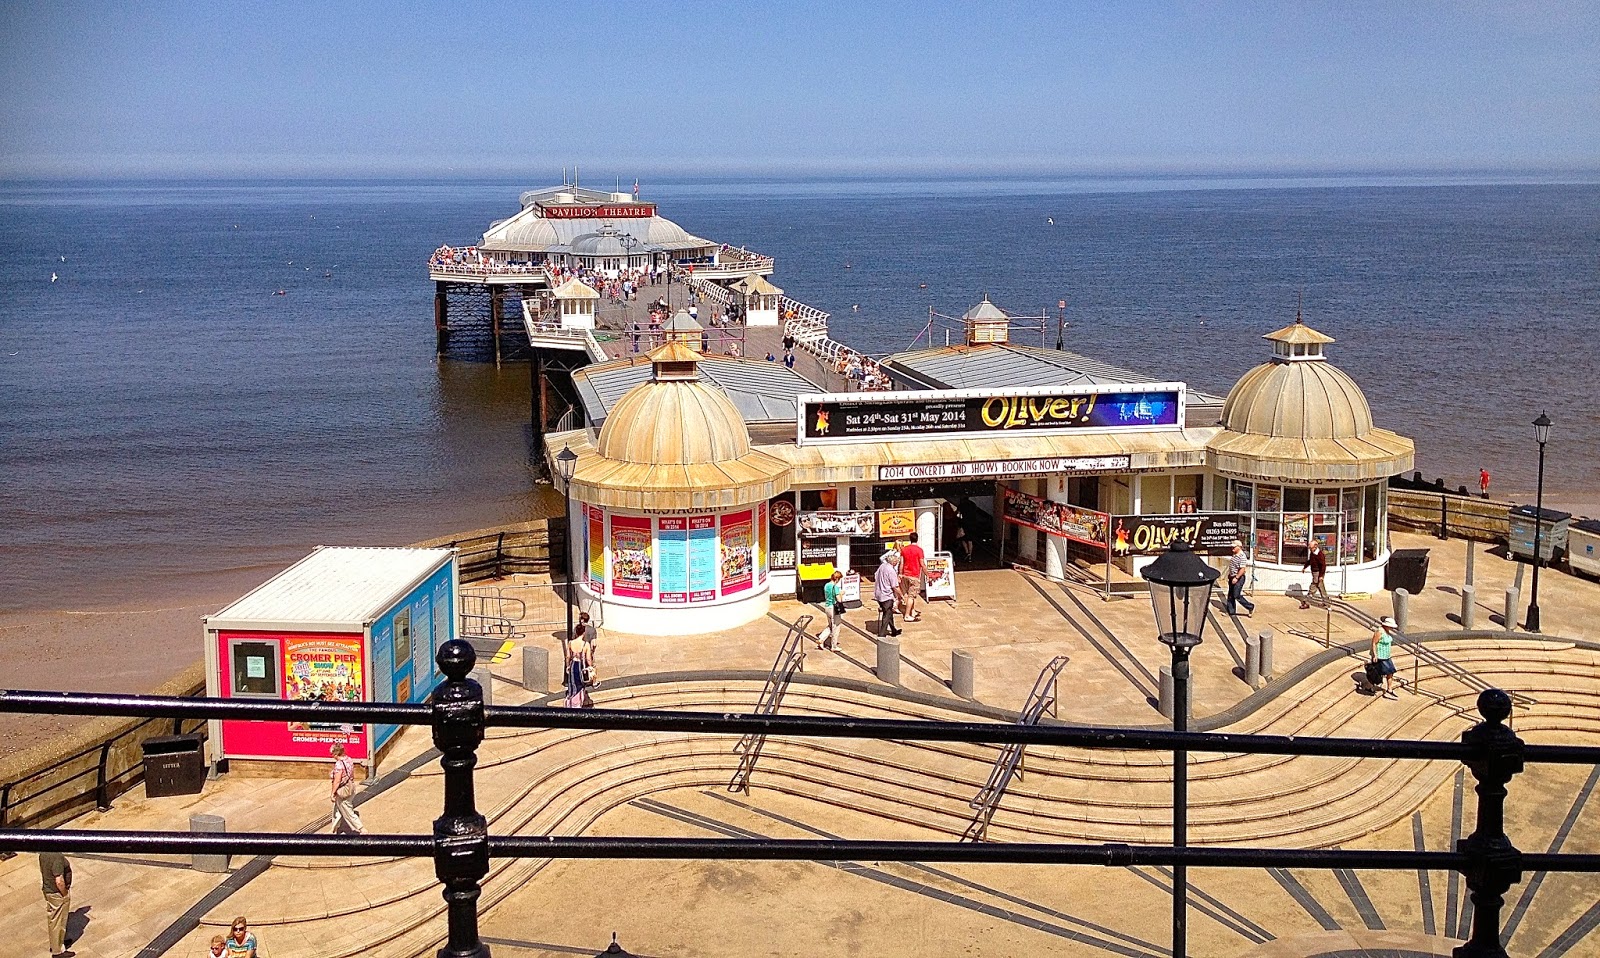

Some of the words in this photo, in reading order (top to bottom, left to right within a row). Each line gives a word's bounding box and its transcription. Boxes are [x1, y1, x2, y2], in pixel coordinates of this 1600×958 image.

[552, 208, 598, 216] PAVILION
[846, 415, 860, 425] Sat
[901, 412, 918, 423] 31st
[920, 412, 940, 423] May
[942, 411, 966, 420] 2014
[885, 468, 904, 478] 2014
[910, 466, 946, 476] CONCERTS
[951, 465, 966, 474] AND
[972, 463, 998, 474] SHOWS
[1002, 461, 1037, 472] BOOKING
[1040, 460, 1060, 470] NOW
[290, 654, 331, 662] CROMER
